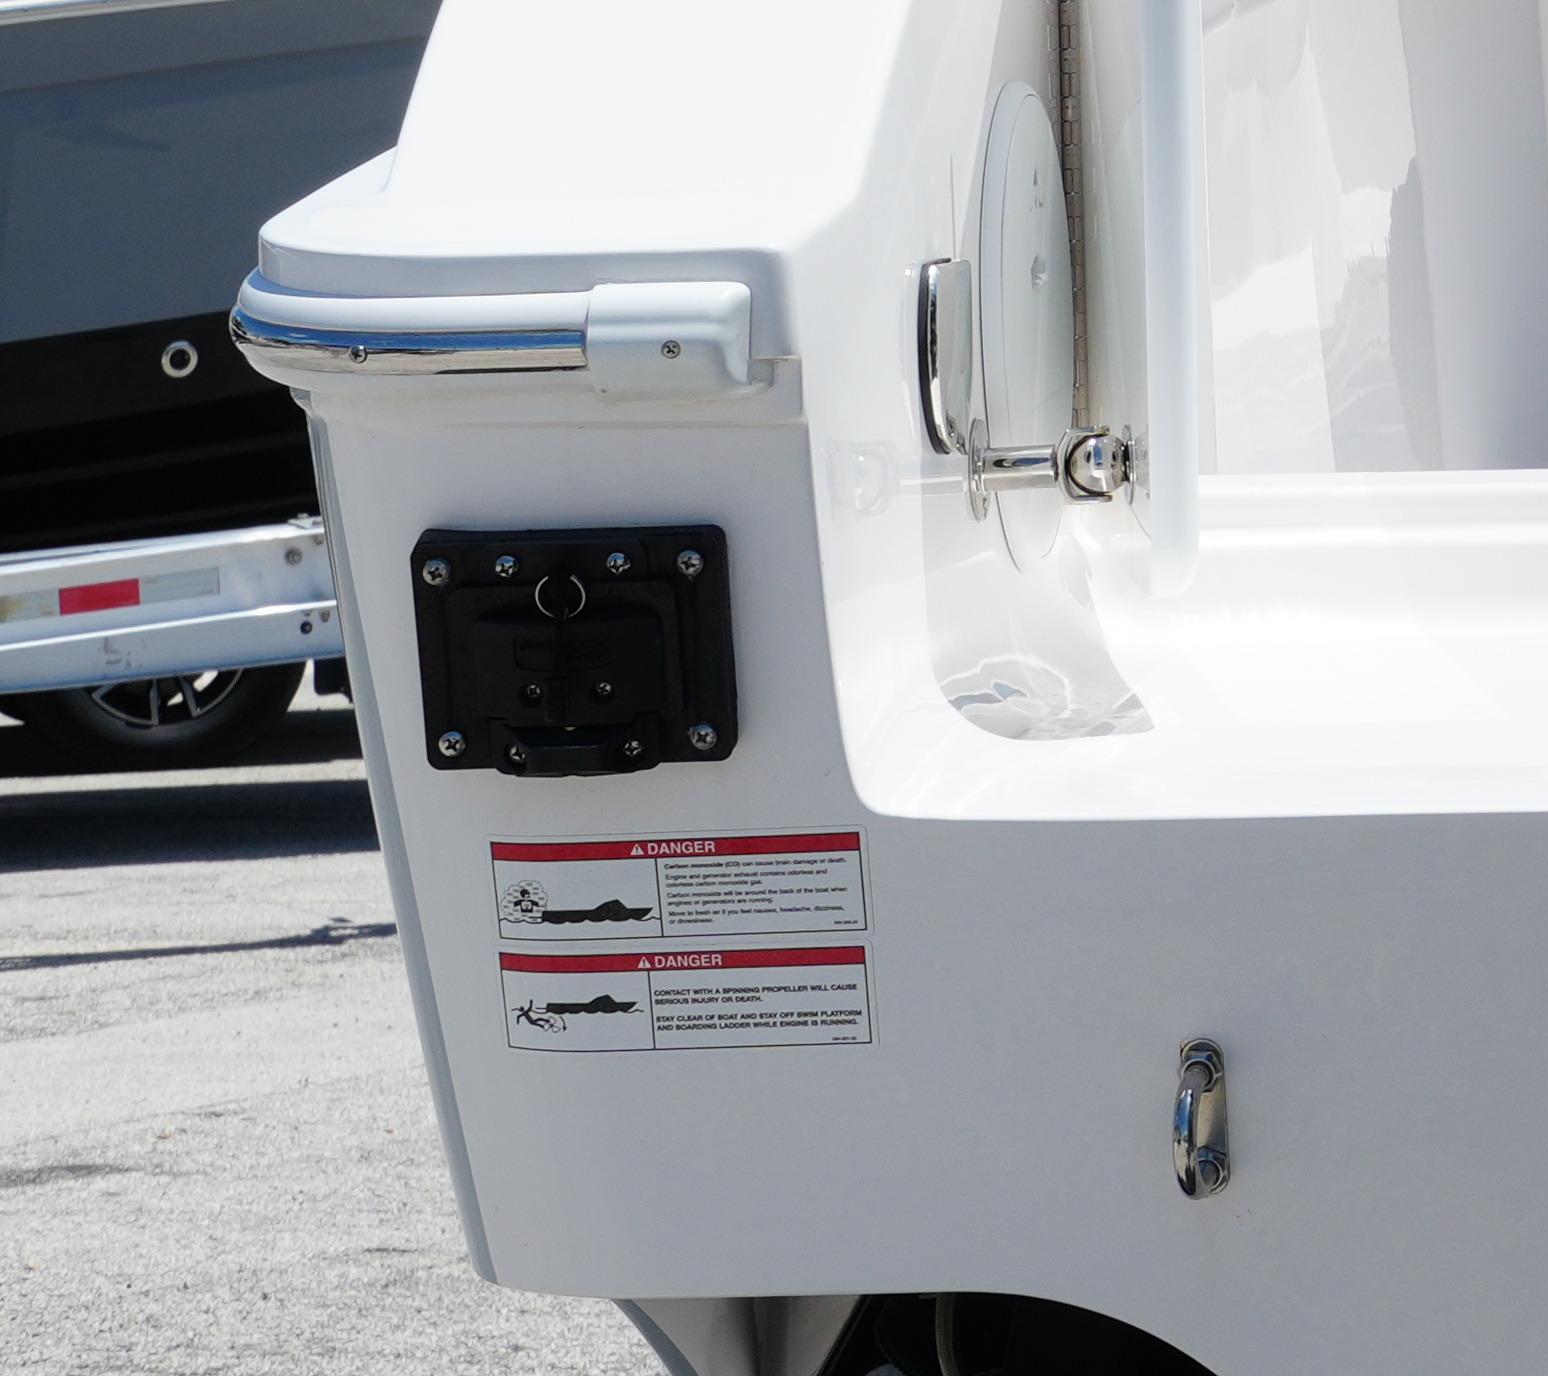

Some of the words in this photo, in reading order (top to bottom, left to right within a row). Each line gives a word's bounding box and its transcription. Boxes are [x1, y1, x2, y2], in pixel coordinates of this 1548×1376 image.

[647, 841, 716, 855] DANGER
[654, 954, 722, 968] DANGER
[653, 988, 691, 996] CONTACT
[762, 985, 809, 993] PROPELLER
[809, 984, 830, 992] WILL
[831, 983, 857, 991] CAUSE
[654, 997, 689, 1005] SERIOUS
[735, 995, 763, 1003] DEATH.
[656, 1015, 675, 1023] STAY
[677, 1014, 703, 1022] CLEAR
[820, 1009, 862, 1017] PLATFORM
[656, 1024, 674, 1032] AND
